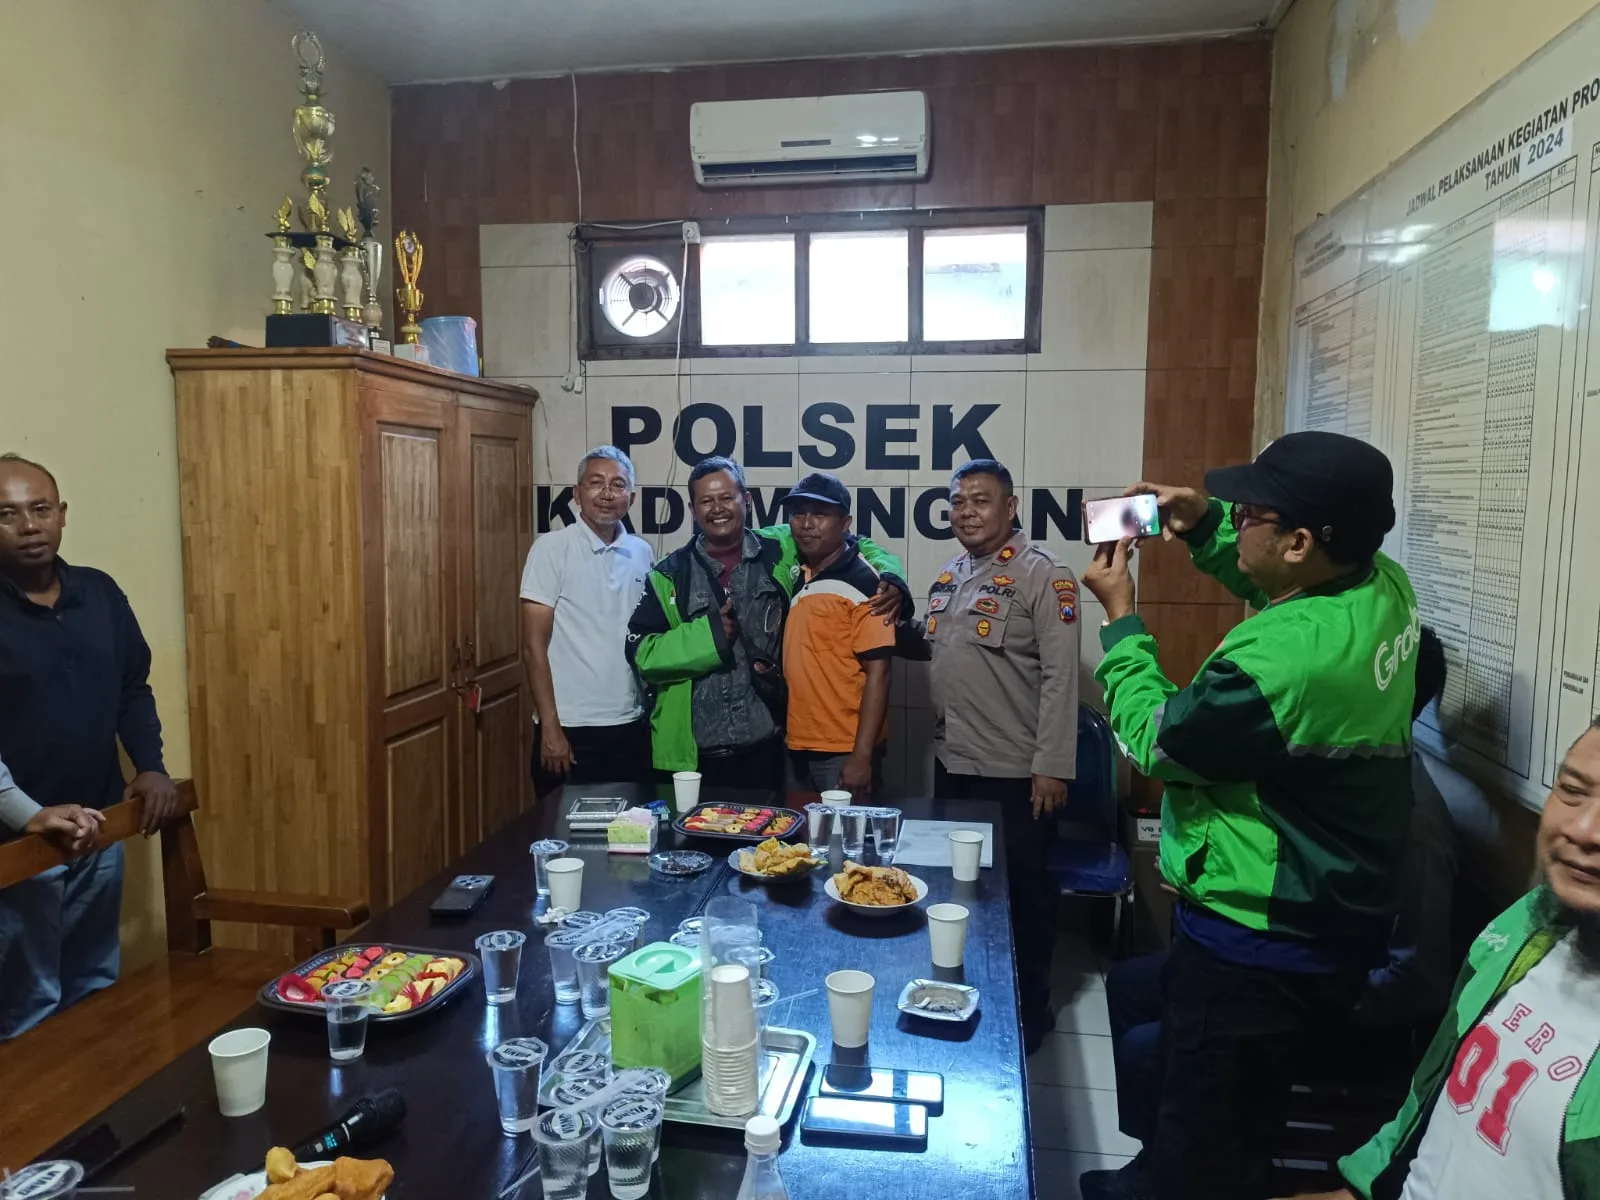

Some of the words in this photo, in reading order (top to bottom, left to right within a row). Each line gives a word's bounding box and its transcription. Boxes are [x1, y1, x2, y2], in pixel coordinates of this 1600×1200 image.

[1406, 184, 1436, 216] JADWAL
[1438, 138, 1504, 196] PELAKSANAAN
[1508, 97, 1568, 152] KEGIATAN
[1484, 153, 1520, 191] TAHUN
[1527, 126, 1563, 165] 2024
[611, 402, 1001, 470] POLSEK
[537, 486, 1084, 541] KDMNGN
[979, 585, 1016, 598] POLRI
[1374, 606, 1421, 691] Grab
[1486, 1002, 1582, 1081] ERO
[1447, 1022, 1538, 1156] 01
